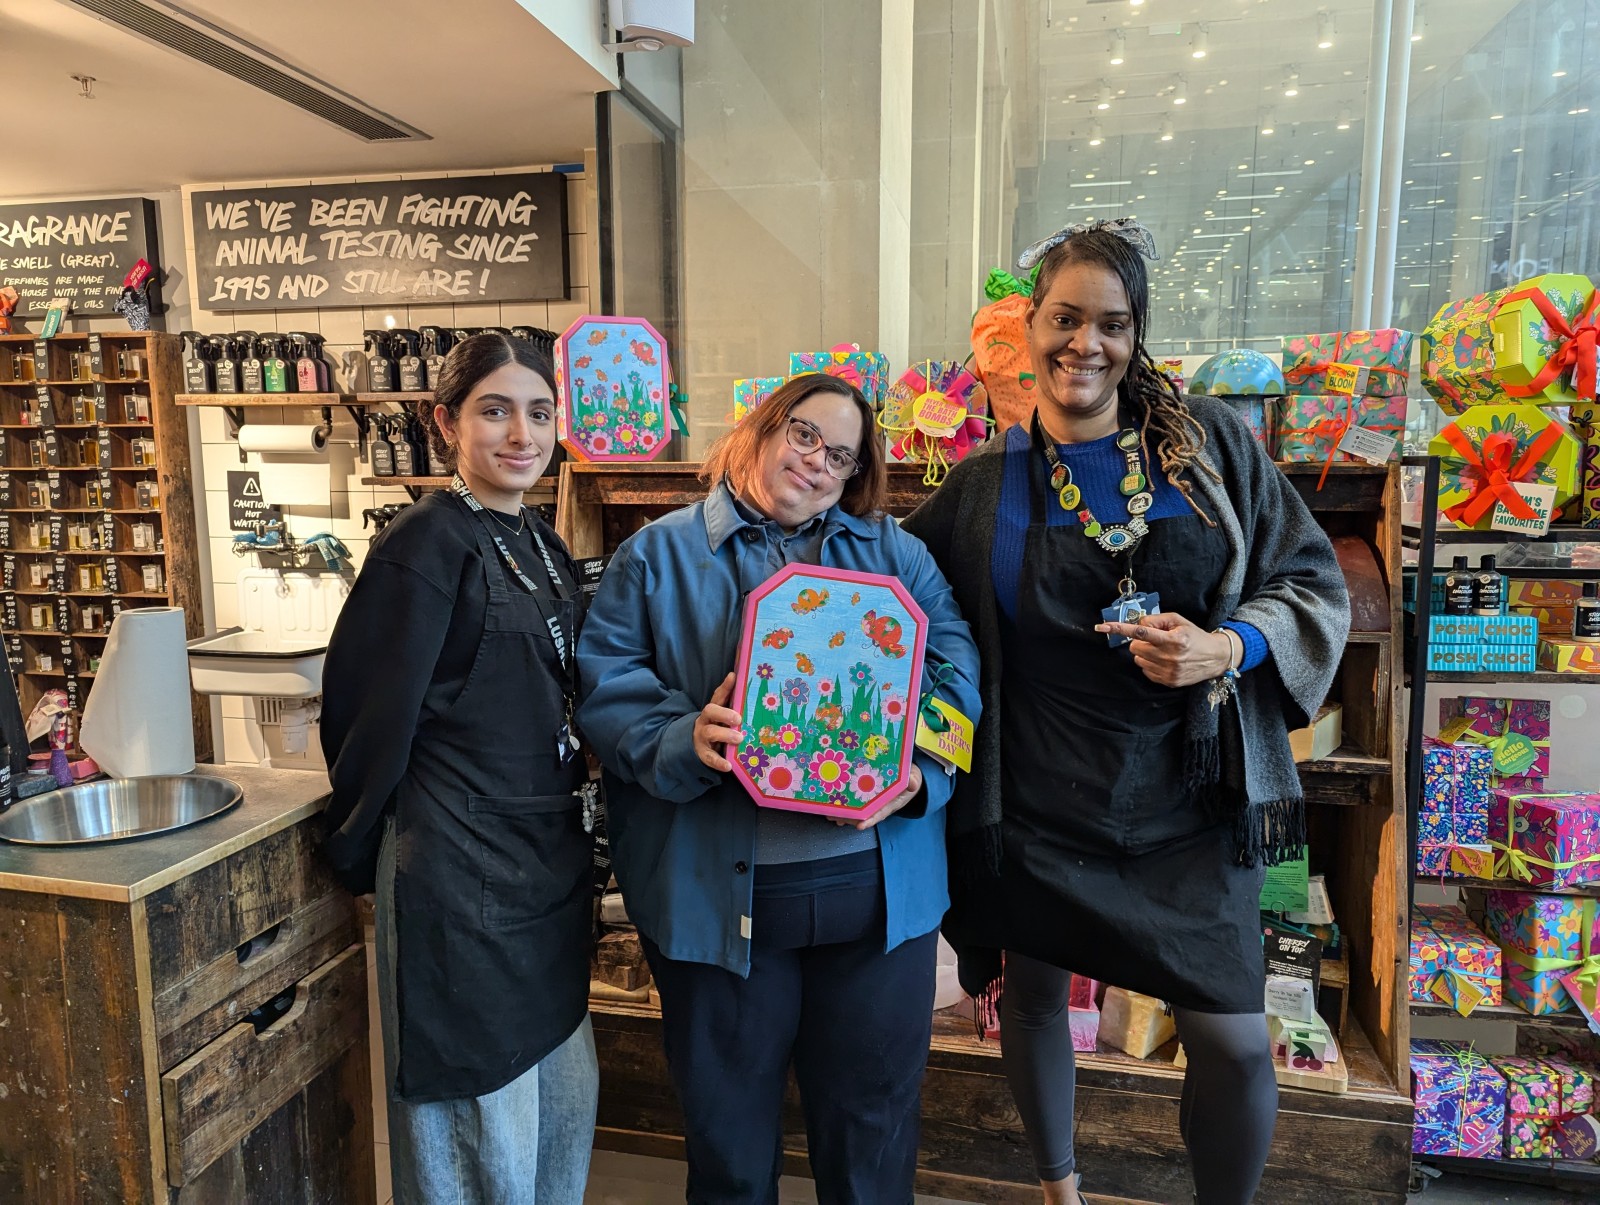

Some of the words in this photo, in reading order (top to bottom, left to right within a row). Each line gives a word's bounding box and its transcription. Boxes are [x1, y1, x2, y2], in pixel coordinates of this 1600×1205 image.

[206, 199, 296, 232] WE'VE
[309, 196, 388, 227] BEEN
[397, 191, 537, 228] FIGHTING
[215, 233, 318, 267] ANIMAL
[320, 229, 443, 262] TESTING
[446, 233, 538, 263] SINCE
[0, 258, 8, 270] E
[11, 257, 52, 269] SMELL
[4, 277, 49, 286] PERFUMES
[56, 276, 73, 284] ARE
[77, 276, 104, 284] MADE
[209, 276, 271, 301] 1995
[278, 273, 329, 300] AND
[342, 269, 406, 296] STILL
[54, 289, 78, 297] WITH
[83, 287, 101, 295] THE
[84, 301, 104, 309] OILS
[1329, 377, 1352, 388] BLOOM
[923, 403, 936, 411] THE
[938, 407, 957, 418] BATH
[919, 410, 953, 426] BOMBS
[451, 473, 470, 497] USH
[233, 499, 270, 509] CAUTION
[245, 510, 262, 518] HOT
[1495, 515, 1545, 529] FAVOURITES
[541, 548, 562, 584] LUSH
[1434, 624, 1479, 635] POSH
[1484, 624, 1532, 636] CHOC
[547, 616, 565, 661] LUSH
[1433, 652, 1478, 663] POSH
[1483, 653, 1530, 664] CHOC
[938, 738, 956, 756] DAY
[1279, 937, 1310, 948] CHERRY
[1291, 946, 1305, 954] TOP
